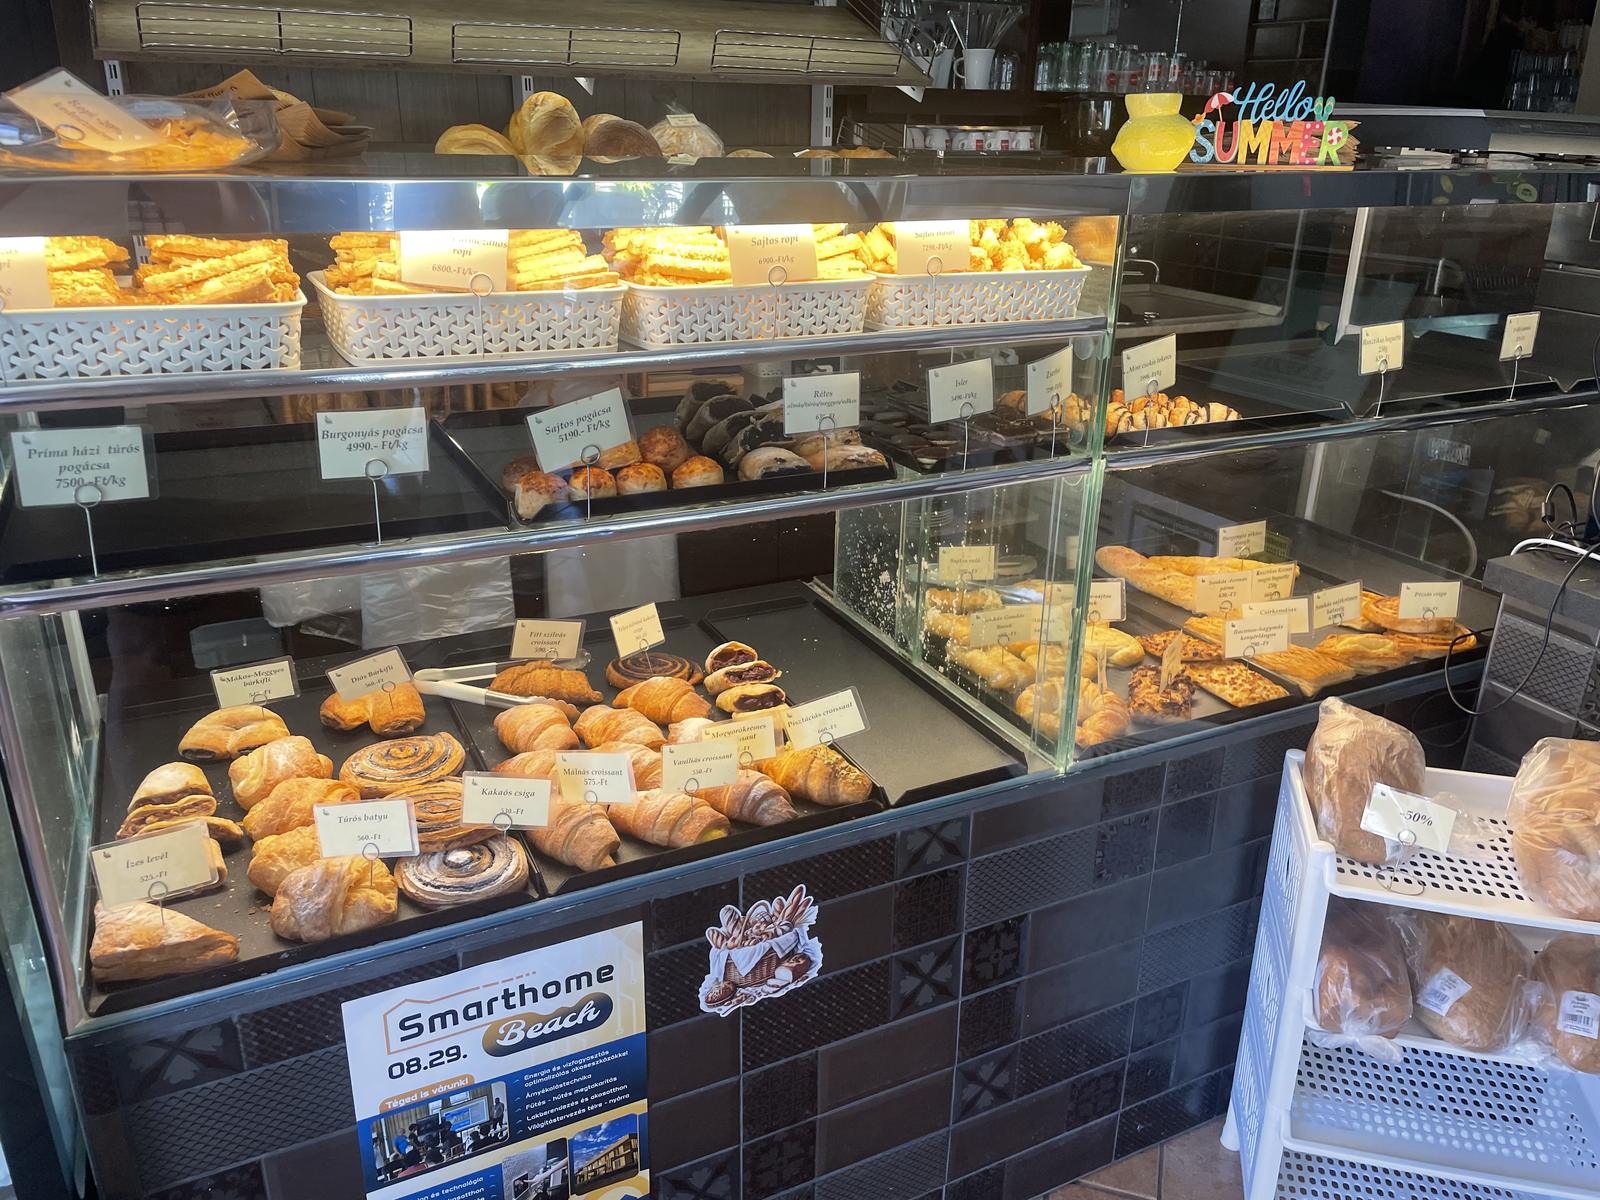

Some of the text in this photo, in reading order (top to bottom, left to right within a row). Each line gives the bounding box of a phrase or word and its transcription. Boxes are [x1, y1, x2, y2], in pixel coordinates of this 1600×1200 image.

[1233, 80, 1315, 124] Hello
[1190, 118, 1349, 164] SUMMER
[751, 234, 798, 248] Sajtos ropi
[452, 248, 472, 258] ropi
[813, 390, 833, 399] Rétes
[545, 406, 612, 436] Sajtos pogácsa
[321, 425, 424, 442] Burgonyás pogácsa
[72, 445, 101, 457] házi
[108, 443, 141, 455] túrós
[58, 461, 111, 476] pogácsa
[530, 640, 560, 648] croissant
[822, 701, 853, 717] croissant
[702, 752, 733, 763] croissant
[563, 767, 623, 777] Málnás croissant
[584, 777, 608, 787] 575.-Ft
[481, 787, 536, 799] Kakaós csiga
[337, 812, 389, 824] Túrós batyu
[146, 851, 169, 864] levél
[399, 964, 615, 1042] Smarthome
[496, 999, 601, 1047] Beach
[388, 1045, 468, 1080] 08.29.
[524, 1068, 551, 1081] Energia
[552, 1064, 561, 1073] és
[524, 1069, 570, 1088] optimalizálás
[386, 1078, 469, 1109] Téged is várunk!
[526, 1084, 628, 1121] Lakberendezés és okosotthon
[430, 1176, 484, 1199] és technológia
